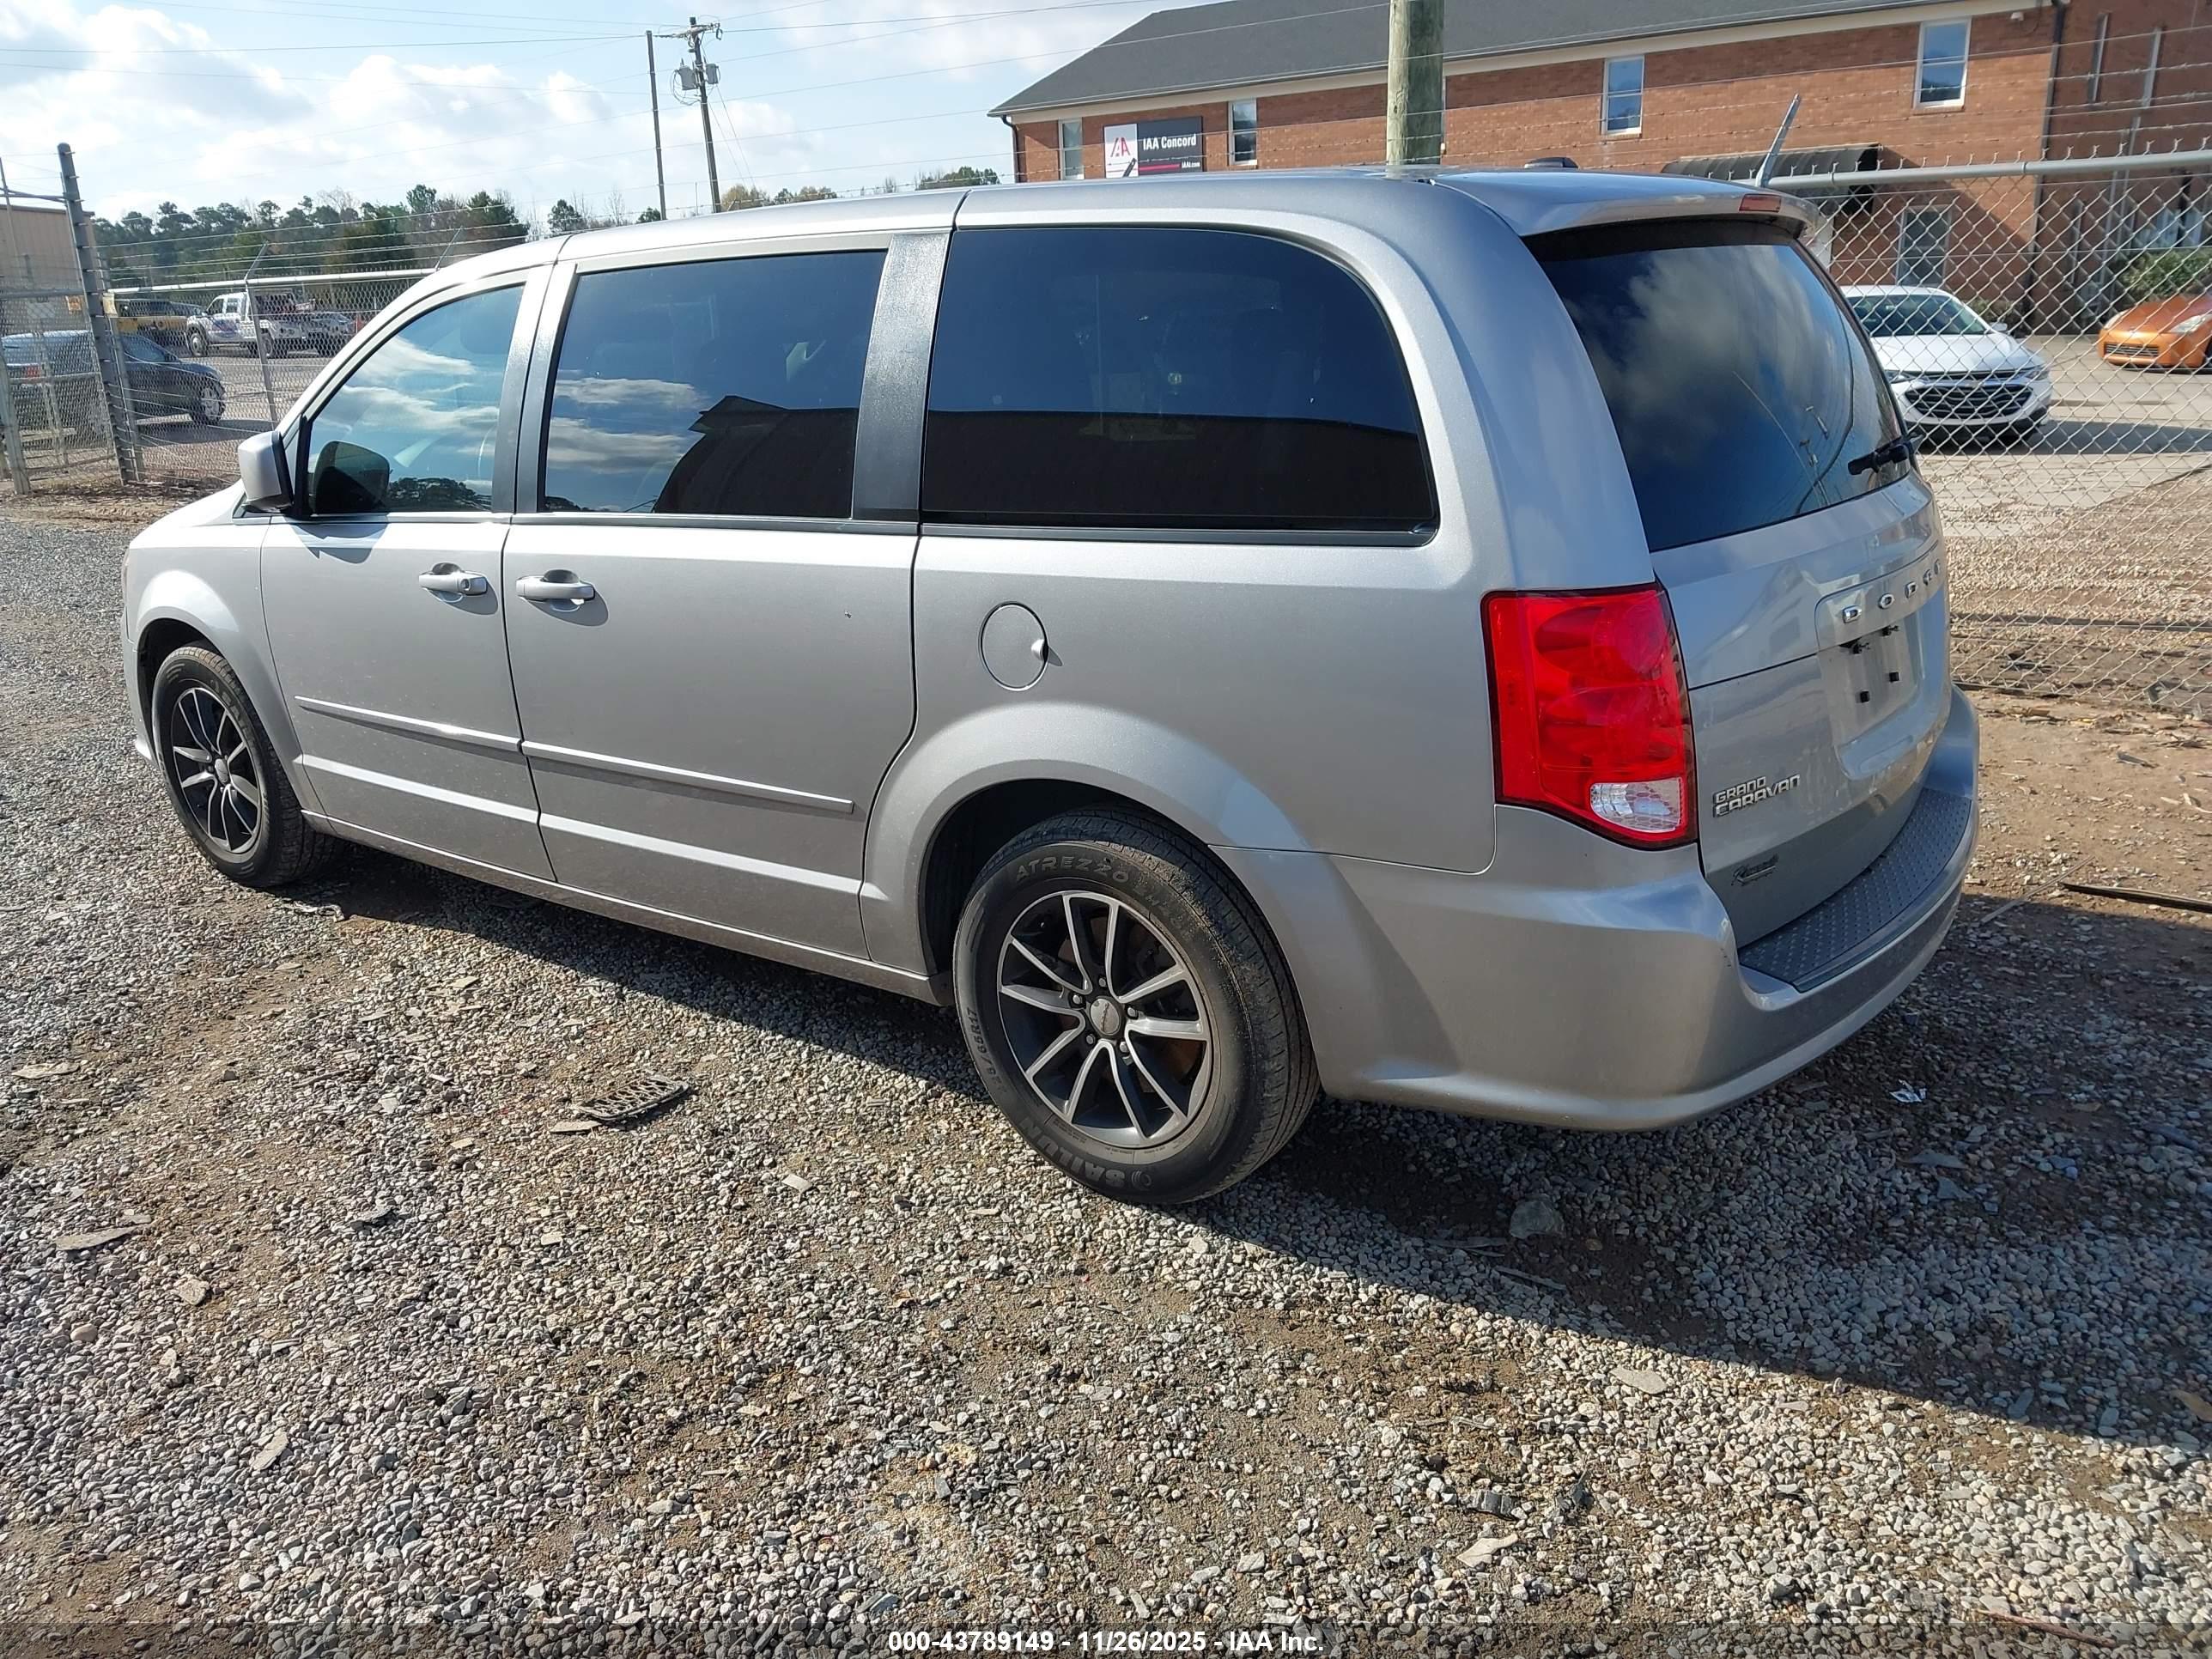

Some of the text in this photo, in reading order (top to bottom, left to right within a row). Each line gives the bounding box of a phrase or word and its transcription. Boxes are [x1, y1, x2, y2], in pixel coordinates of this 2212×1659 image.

[1143, 134, 1196, 150] IAA Concord
[1713, 776, 1766, 804] GRAND
[1713, 774, 1801, 817] CARAVAN
[1018, 1118, 1126, 1188] SAILUN
